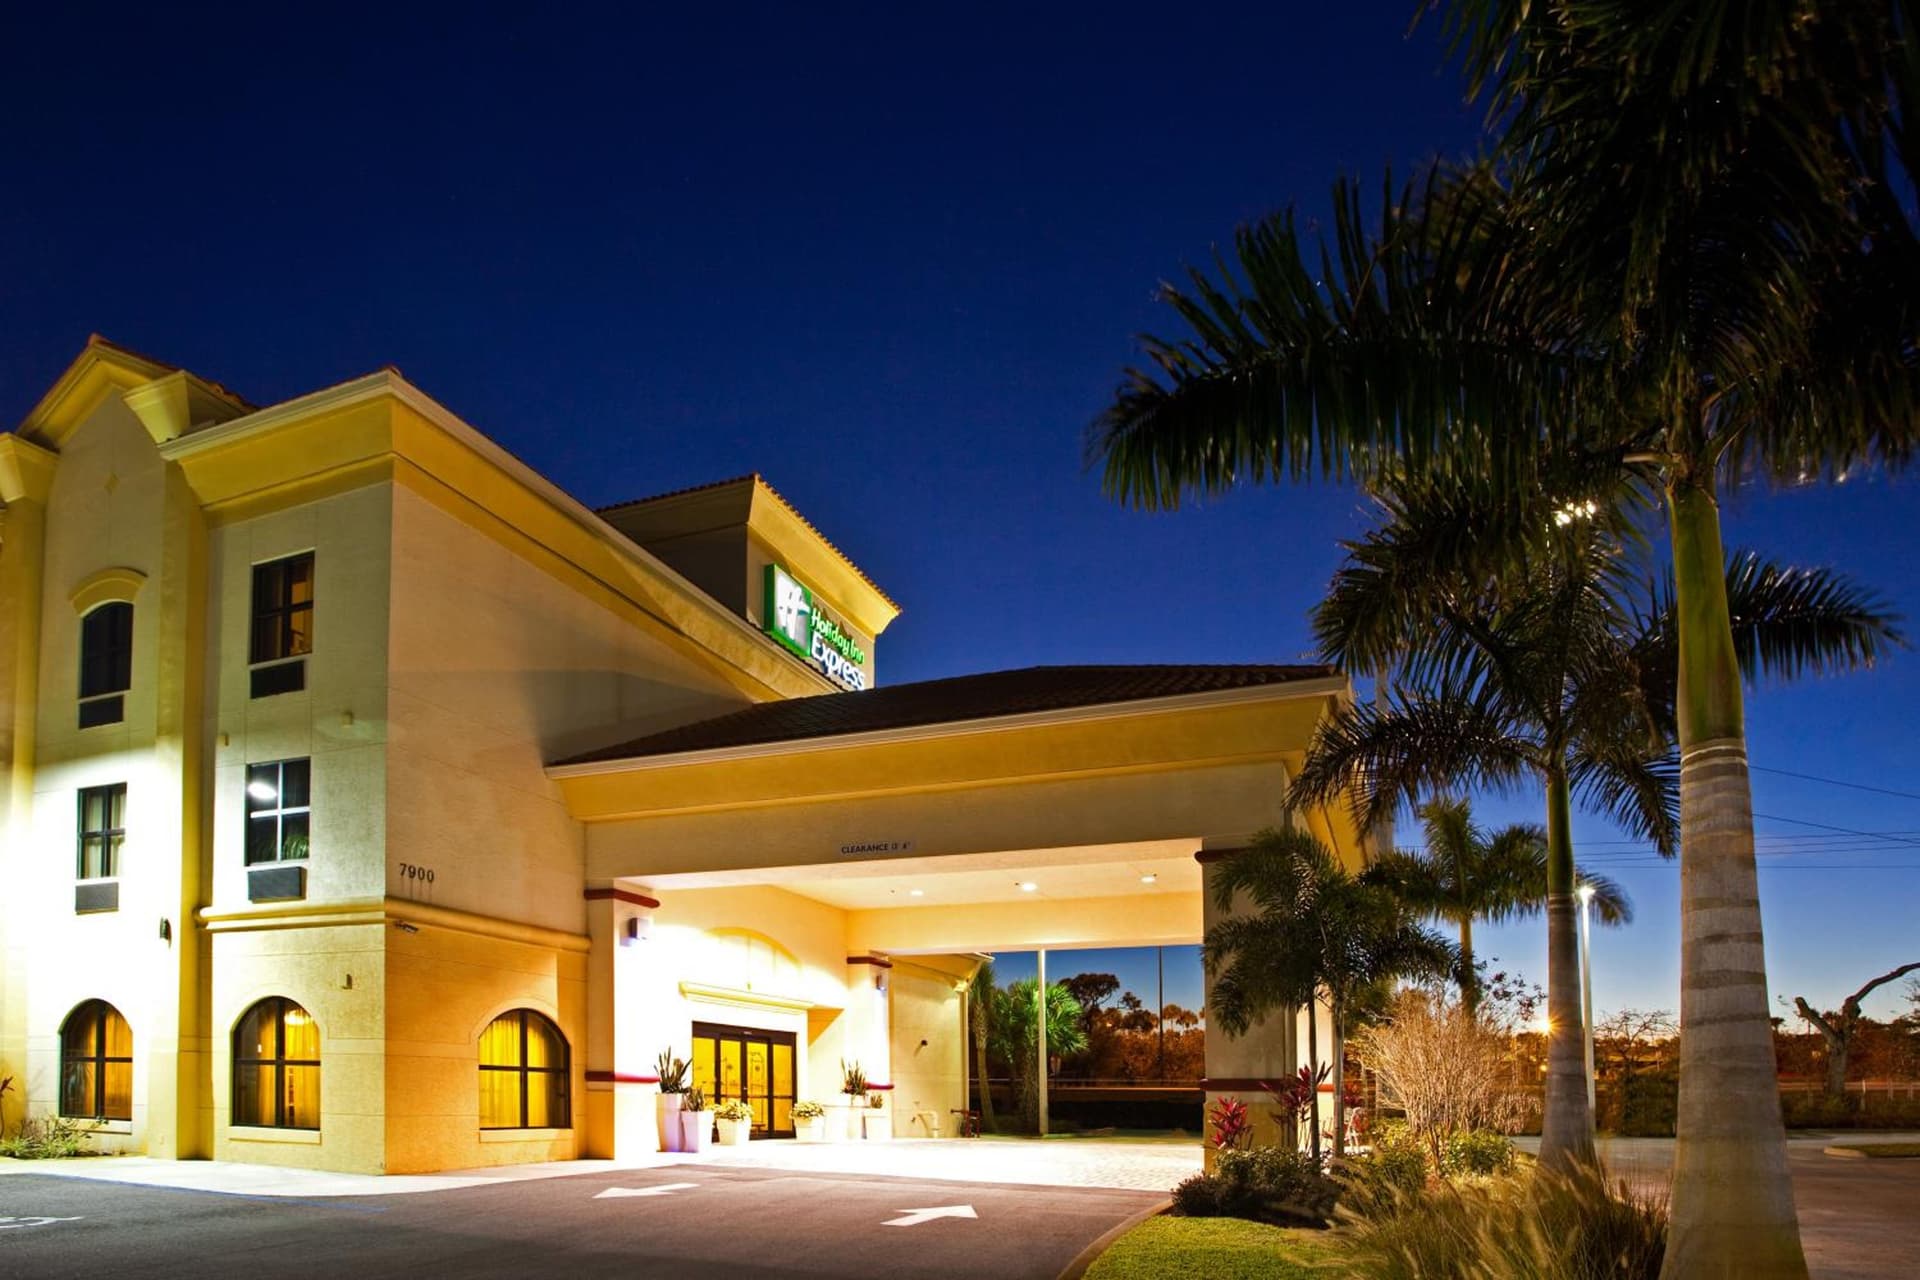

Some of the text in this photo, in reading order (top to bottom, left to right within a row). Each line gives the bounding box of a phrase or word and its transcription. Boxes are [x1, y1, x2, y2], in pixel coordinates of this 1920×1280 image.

[811, 607, 865, 665] Holiday Inn
[811, 630, 865, 690] Express
[841, 843, 889, 854] CLEARANCE
[400, 863, 434, 883] 7900
